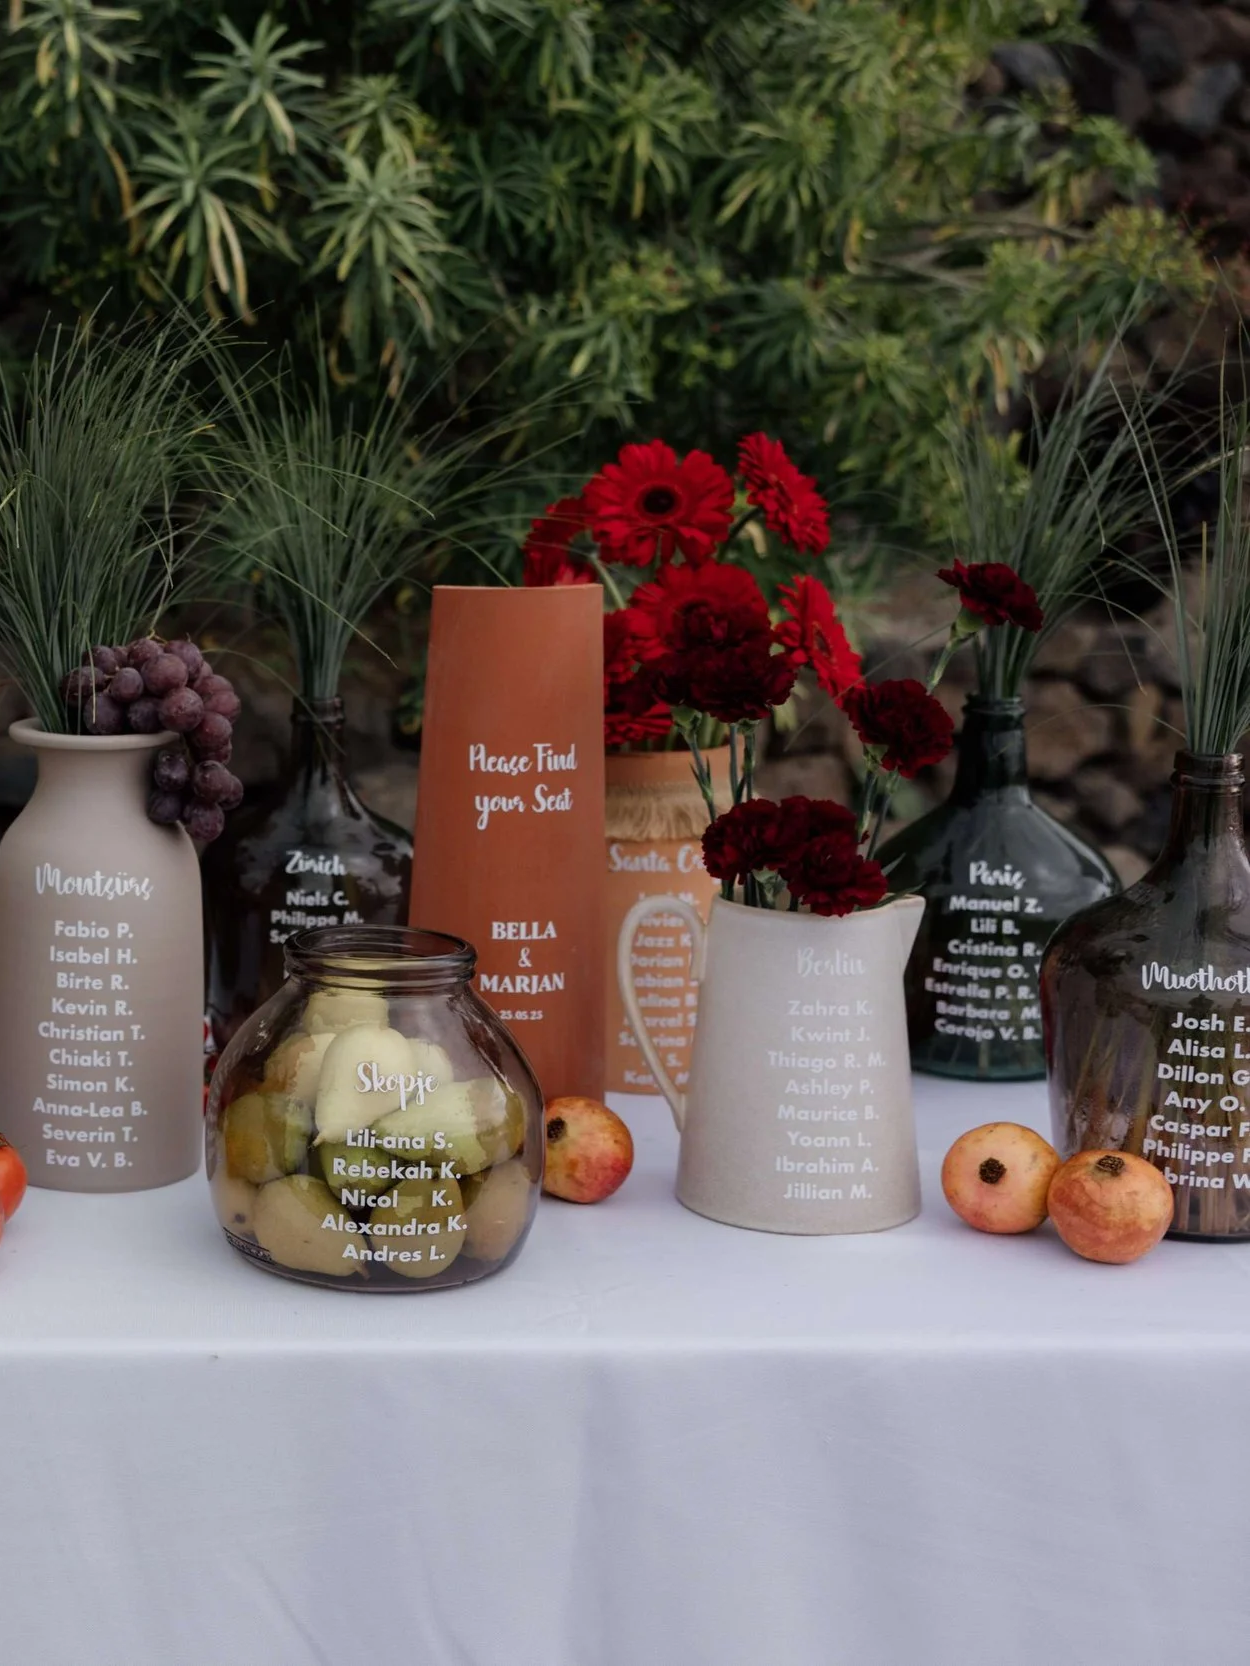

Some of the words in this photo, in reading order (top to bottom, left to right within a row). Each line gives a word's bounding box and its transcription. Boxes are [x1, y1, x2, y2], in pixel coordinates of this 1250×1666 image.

[469, 743, 533, 776] Please
[532, 743, 578, 772] Find
[474, 793, 527, 831] your
[532, 783, 574, 814] Seat
[285, 850, 348, 876] Zürich
[608, 843, 671, 872] Santa
[35, 862, 154, 900] Montsürs
[969, 861, 1026, 890] Paris
[286, 889, 329, 906] Niels
[333, 891, 349, 906] C.
[950, 895, 1020, 912] Manuel
[1024, 898, 1043, 913] Z.
[54, 920, 110, 938] Fabio
[117, 923, 134, 938] P.
[271, 910, 338, 928] Philippe
[343, 911, 364, 924] M.
[970, 918, 996, 934] Lili
[1002, 919, 1020, 935] B.
[491, 921, 558, 940] BELLA
[50, 946, 109, 964] Isabel
[117, 948, 138, 964] H.
[518, 947, 532, 968] &
[947, 939, 1018, 957] Cristina
[1022, 942, 1042, 957] R.
[796, 947, 866, 977] Berlin
[932, 957, 1002, 980] Enrique
[1006, 964, 1030, 978] O.
[57, 972, 103, 990] Birte
[111, 974, 129, 990] R.
[479, 972, 565, 995] MARJAN
[924, 977, 991, 999] Estrella
[995, 985, 1012, 999] P.
[1017, 986, 1036, 1000] R.
[52, 998, 107, 1015] Kevin
[115, 1000, 132, 1015] R.
[788, 1000, 849, 1016] Zahra
[856, 1000, 872, 1016] K.
[936, 1000, 1010, 1020] Barbara
[38, 1021, 124, 1041] Christian
[131, 1025, 145, 1040] T.
[1171, 1012, 1225, 1032] Josh
[791, 1027, 852, 1042] Kwint
[857, 1027, 870, 1042] J.
[1000, 1027, 1018, 1040] V.
[1023, 1026, 1041, 1040] B.
[49, 1048, 111, 1067] Chiaki
[118, 1051, 133, 1066] T.
[1167, 1039, 1225, 1059] Alisa
[767, 1051, 836, 1072] Thiago
[844, 1054, 861, 1068] R.
[868, 1051, 886, 1067] M.
[46, 1074, 107, 1092] Simon
[115, 1076, 134, 1092] K.
[1158, 1063, 1224, 1085] Dillon
[355, 1062, 439, 1111] Skopje
[785, 1079, 852, 1099] Ashley
[860, 1080, 874, 1095] P.
[32, 1097, 124, 1117] Anna-Lea
[131, 1101, 148, 1116] B.
[777, 1104, 857, 1121] Maurice
[865, 1105, 879, 1120] B.
[1164, 1091, 1212, 1114] Any
[1220, 1095, 1246, 1112] O.
[42, 1123, 115, 1142] Severin
[122, 1126, 138, 1142] T.
[1150, 1115, 1232, 1140] Caspar
[346, 1129, 425, 1149] Lili-ana
[433, 1131, 453, 1149] S.
[787, 1131, 850, 1147] Yoann
[858, 1132, 872, 1146] L.
[46, 1149, 80, 1167] Eva
[87, 1152, 107, 1168] V.
[114, 1152, 133, 1167] B.
[1142, 1138, 1235, 1167] Philippe
[332, 1157, 432, 1179] Rebekah
[440, 1161, 462, 1179] K.
[775, 1156, 854, 1174] Ibrahim
[861, 1158, 879, 1173] A.
[341, 1188, 398, 1208] Nicol
[432, 1189, 453, 1207] K.
[783, 1182, 842, 1200] Jillian
[850, 1184, 872, 1199] M.
[321, 1213, 440, 1236] Alexandra
[447, 1214, 468, 1232] K.
[342, 1243, 422, 1262] Andres
[429, 1245, 446, 1261] L.
